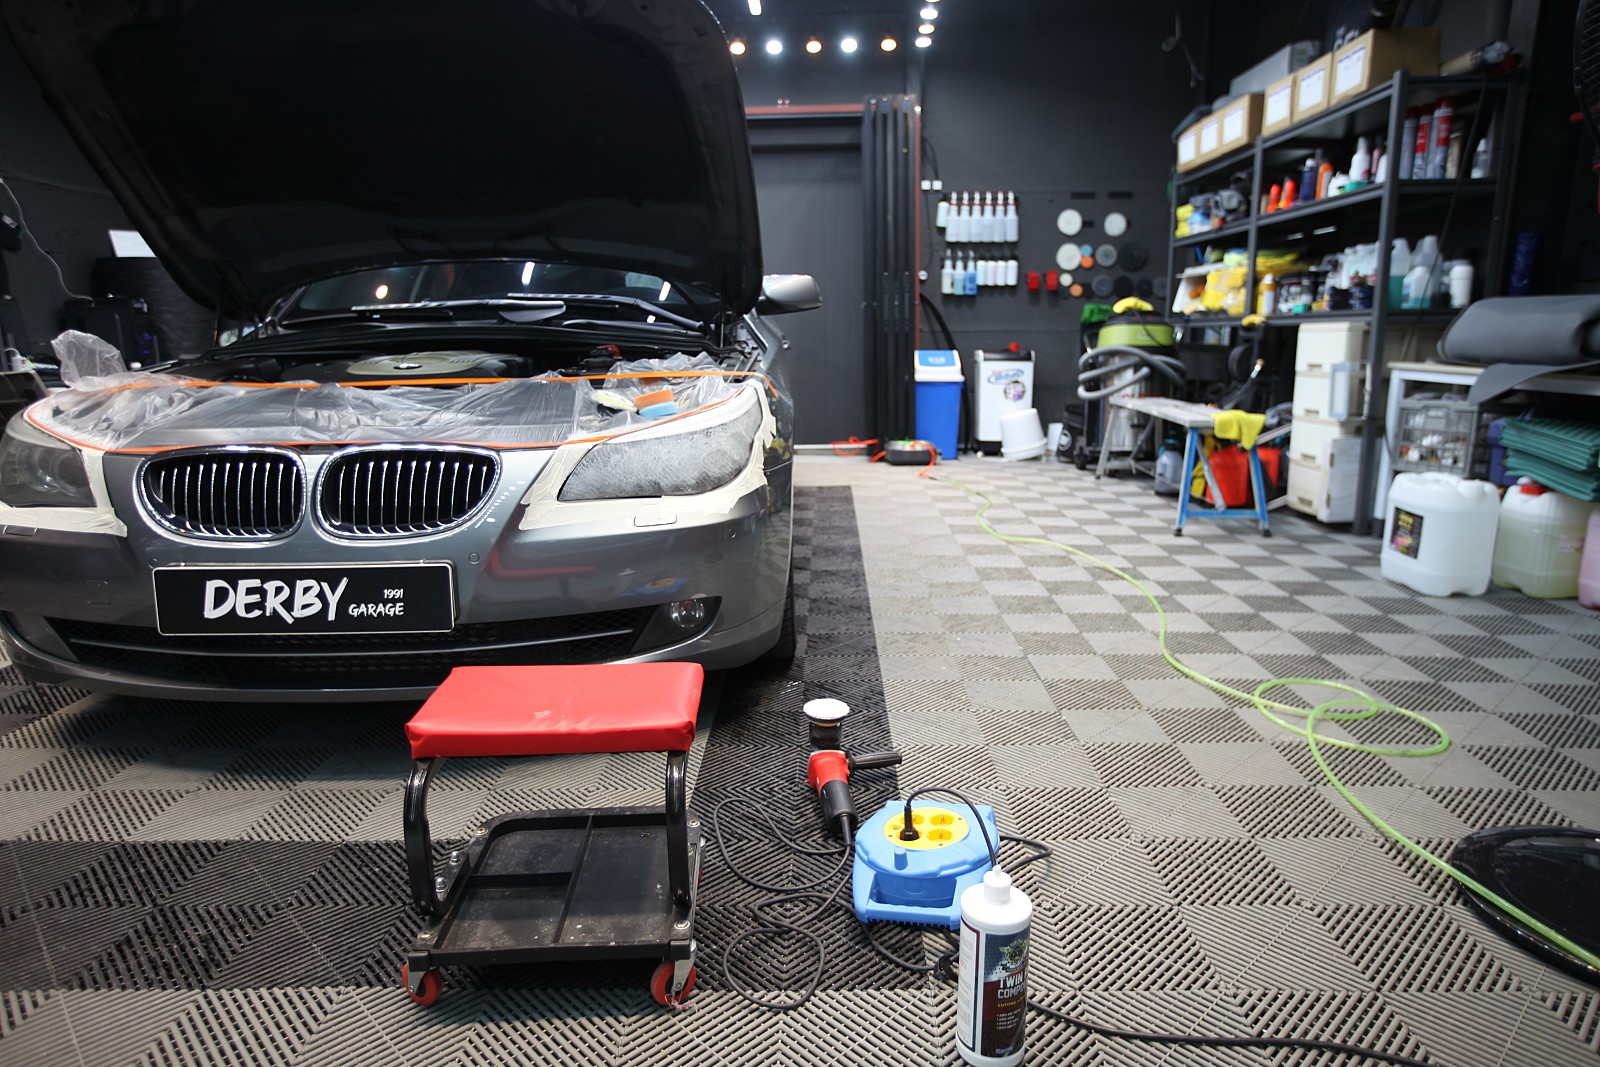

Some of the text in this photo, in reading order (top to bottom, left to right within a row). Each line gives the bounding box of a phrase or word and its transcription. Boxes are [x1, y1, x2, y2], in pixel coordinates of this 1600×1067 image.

[204, 577, 348, 624] DERBY
[383, 588, 404, 599] 1991
[348, 602, 404, 618] GARAGE
[998, 971, 1024, 989] TWIN
